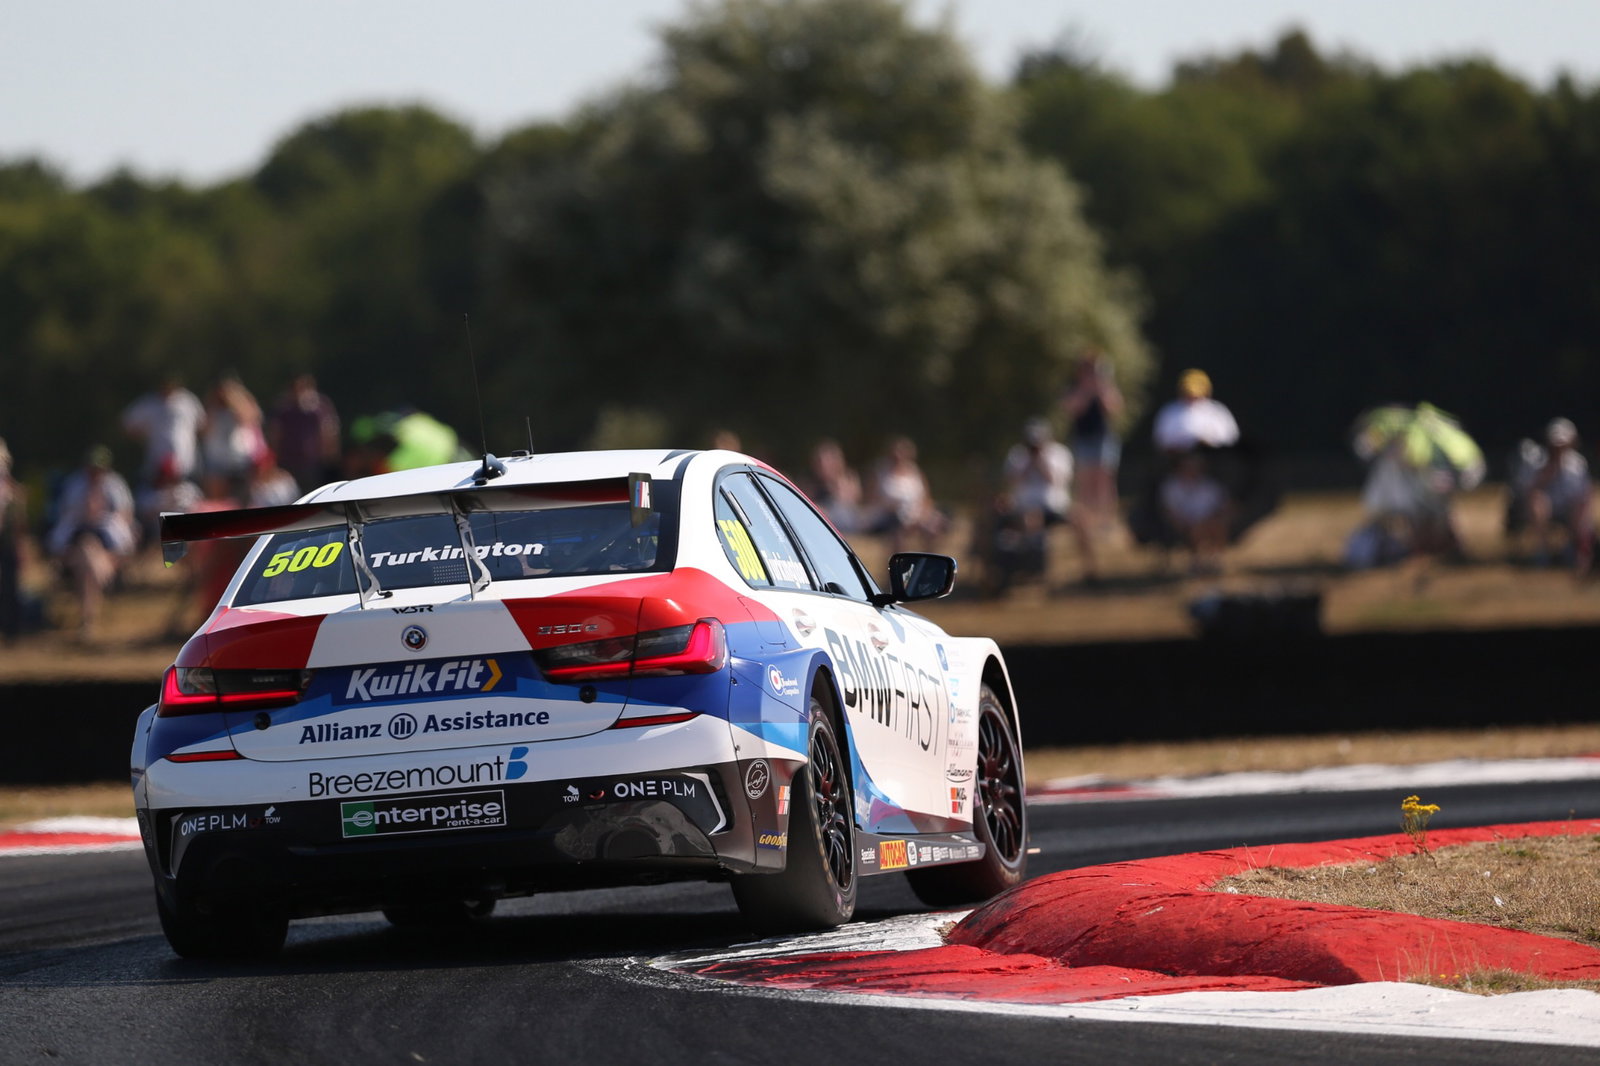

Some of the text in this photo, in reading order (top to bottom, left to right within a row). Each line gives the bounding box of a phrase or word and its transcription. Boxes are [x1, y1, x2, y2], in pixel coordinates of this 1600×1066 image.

[262, 541, 344, 578] 500
[369, 541, 545, 568] Turkington
[391, 604, 434, 615] WSR
[299, 710, 550, 745] Allianz Assistance
[309, 755, 504, 798] Breezemount
[614, 780, 696, 798] ONE PLM
[562, 795, 580, 803] TOW
[181, 813, 247, 836] ONE PLM
[265, 816, 280, 825] TOW
[350, 799, 502, 828] enterprise
[446, 816, 503, 827] rent-a-car
[880, 841, 908, 868] AUTOCAR
